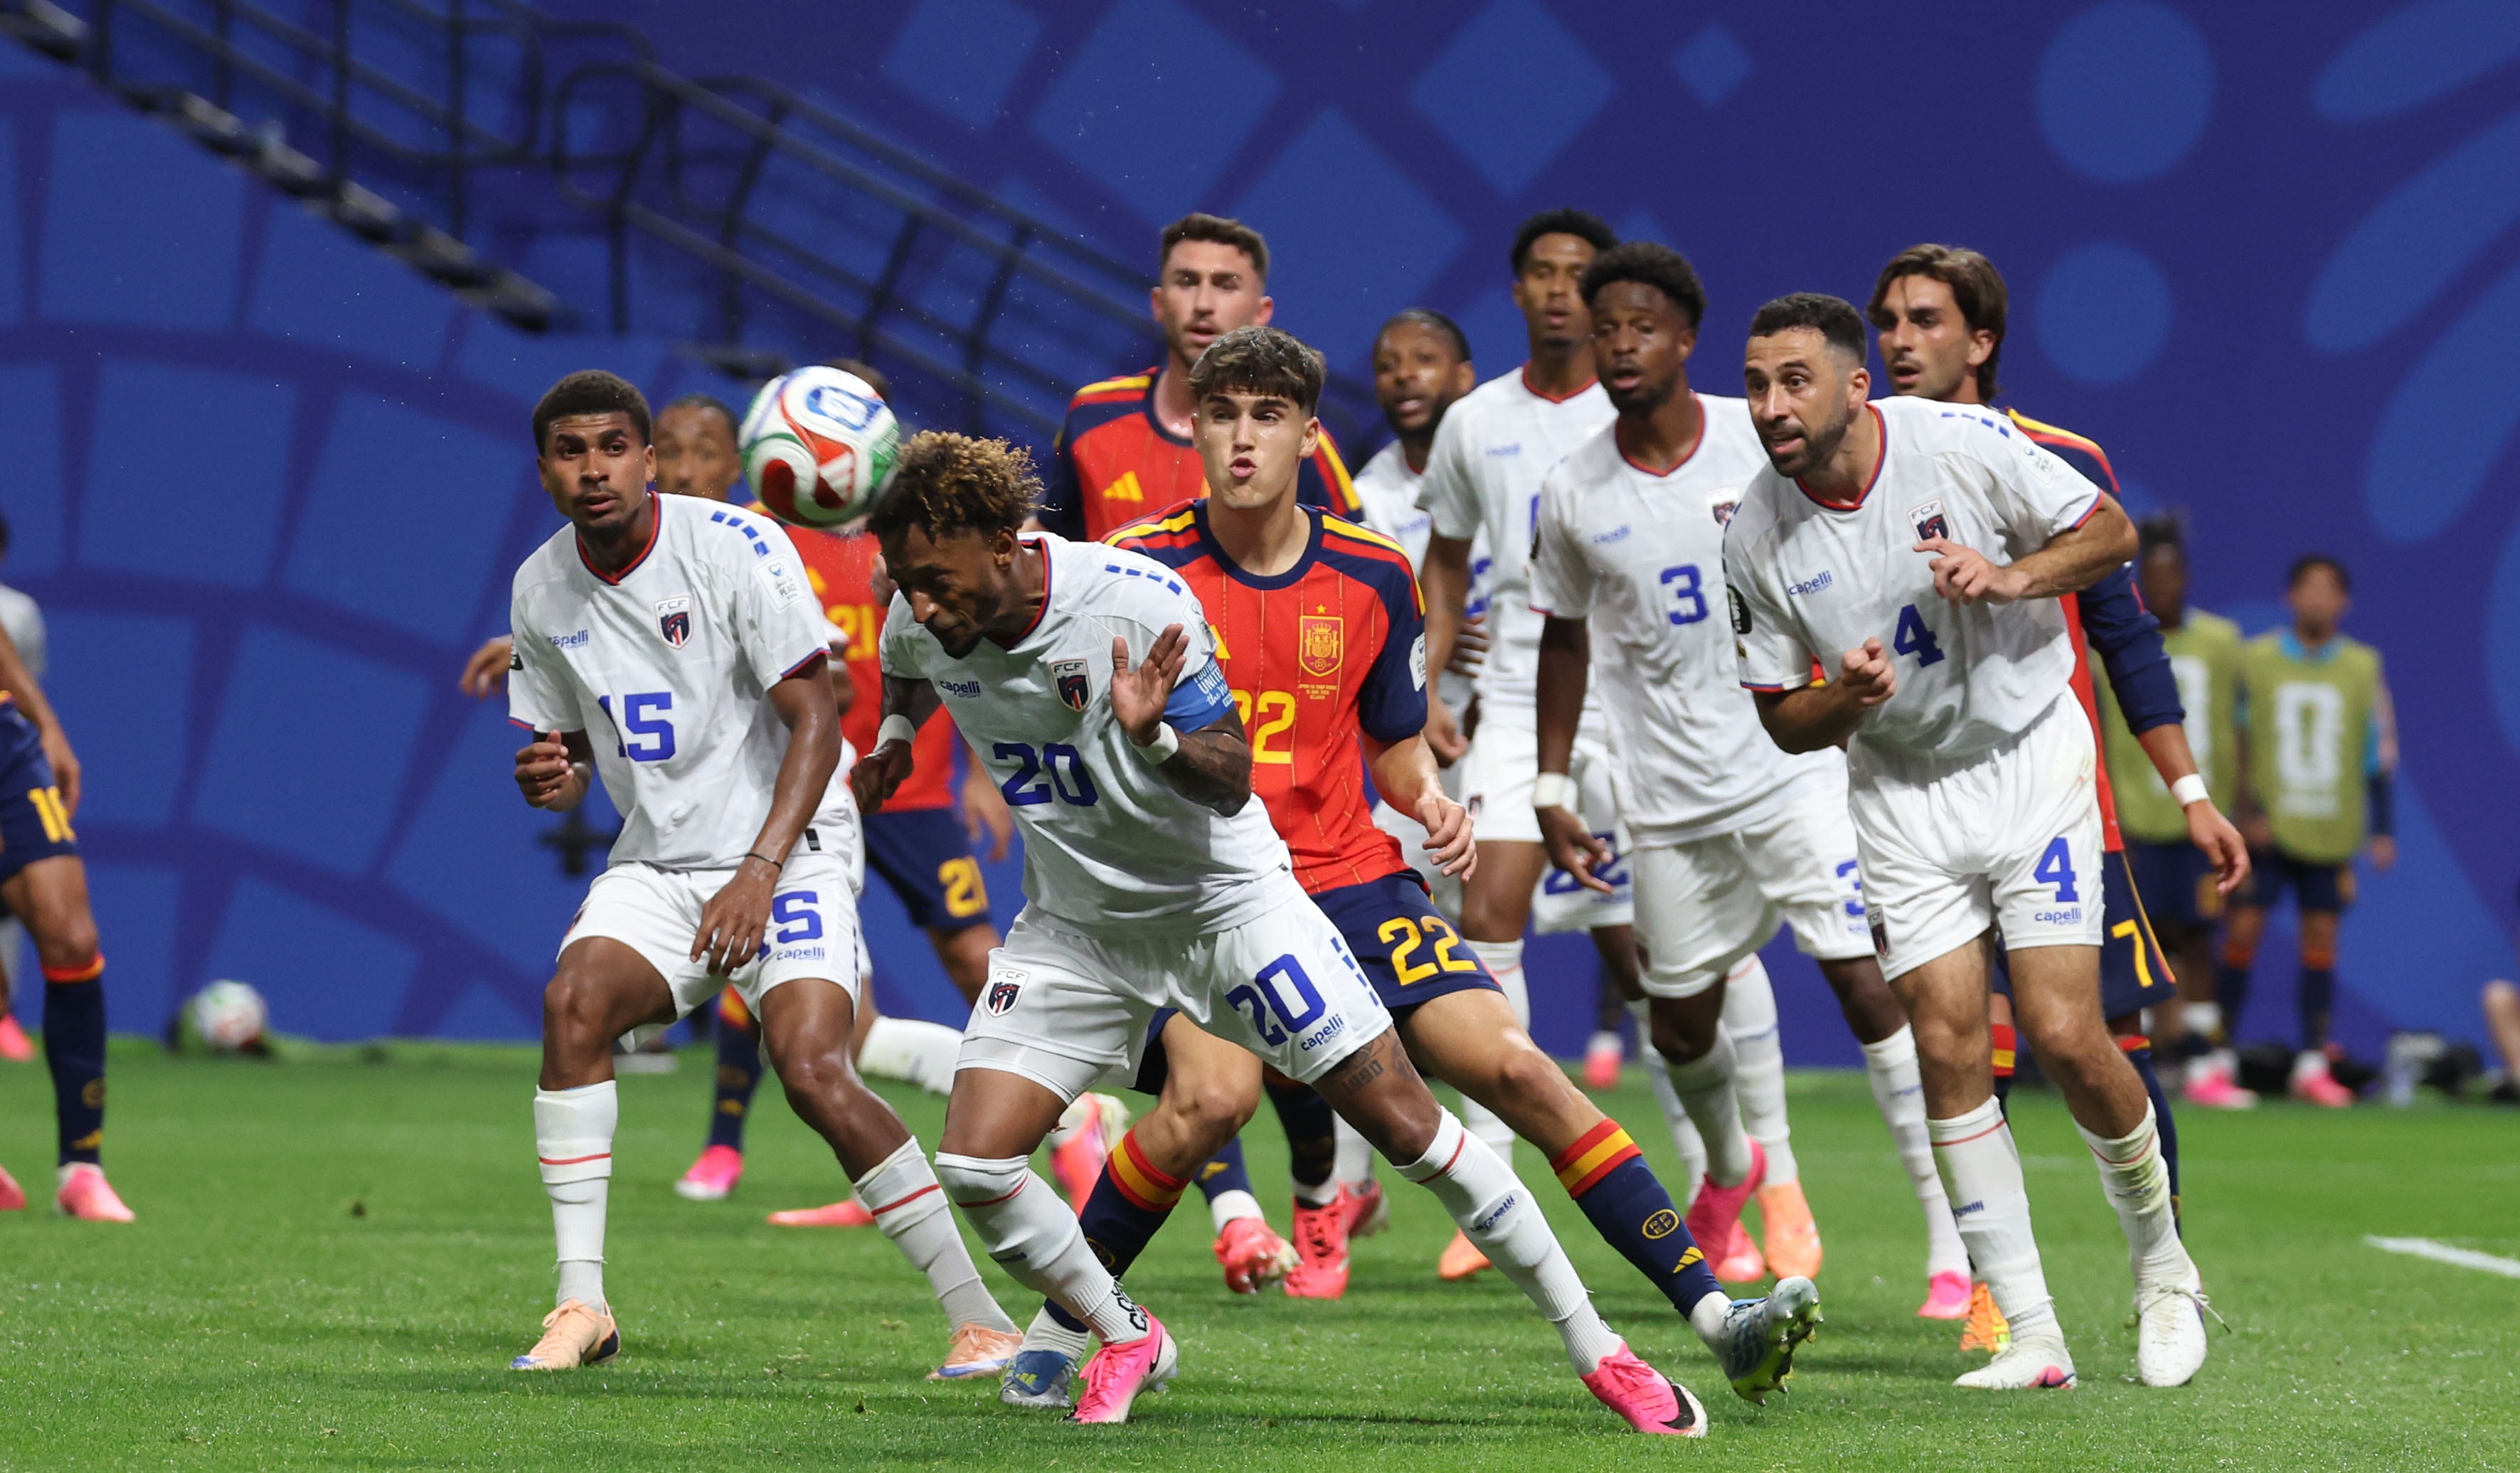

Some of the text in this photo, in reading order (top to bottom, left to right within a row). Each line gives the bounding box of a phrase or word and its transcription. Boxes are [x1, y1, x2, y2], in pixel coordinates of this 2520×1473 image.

[1911, 502, 1938, 519] FCF
[1661, 565, 1709, 624] 3
[1788, 570, 1832, 595] capelli
[659, 600, 686, 611] FCF
[549, 629, 588, 647] apelli
[1894, 604, 1945, 667] 4
[1054, 662, 1083, 673] FCF
[940, 681, 980, 695] capelli
[993, 743, 1098, 806] 20
[2033, 837, 2079, 902] 4
[938, 856, 989, 918] 21
[2035, 908, 2081, 924] capelli
[777, 947, 824, 960] capelli
[1377, 915, 1477, 986] 22
[2111, 919, 2154, 987] 7
[996, 971, 1025, 979] FCF
[1226, 954, 1326, 1047] 20
[1301, 1014, 1344, 1051] capelli
[1324, 1026, 1346, 1044] SPORT
